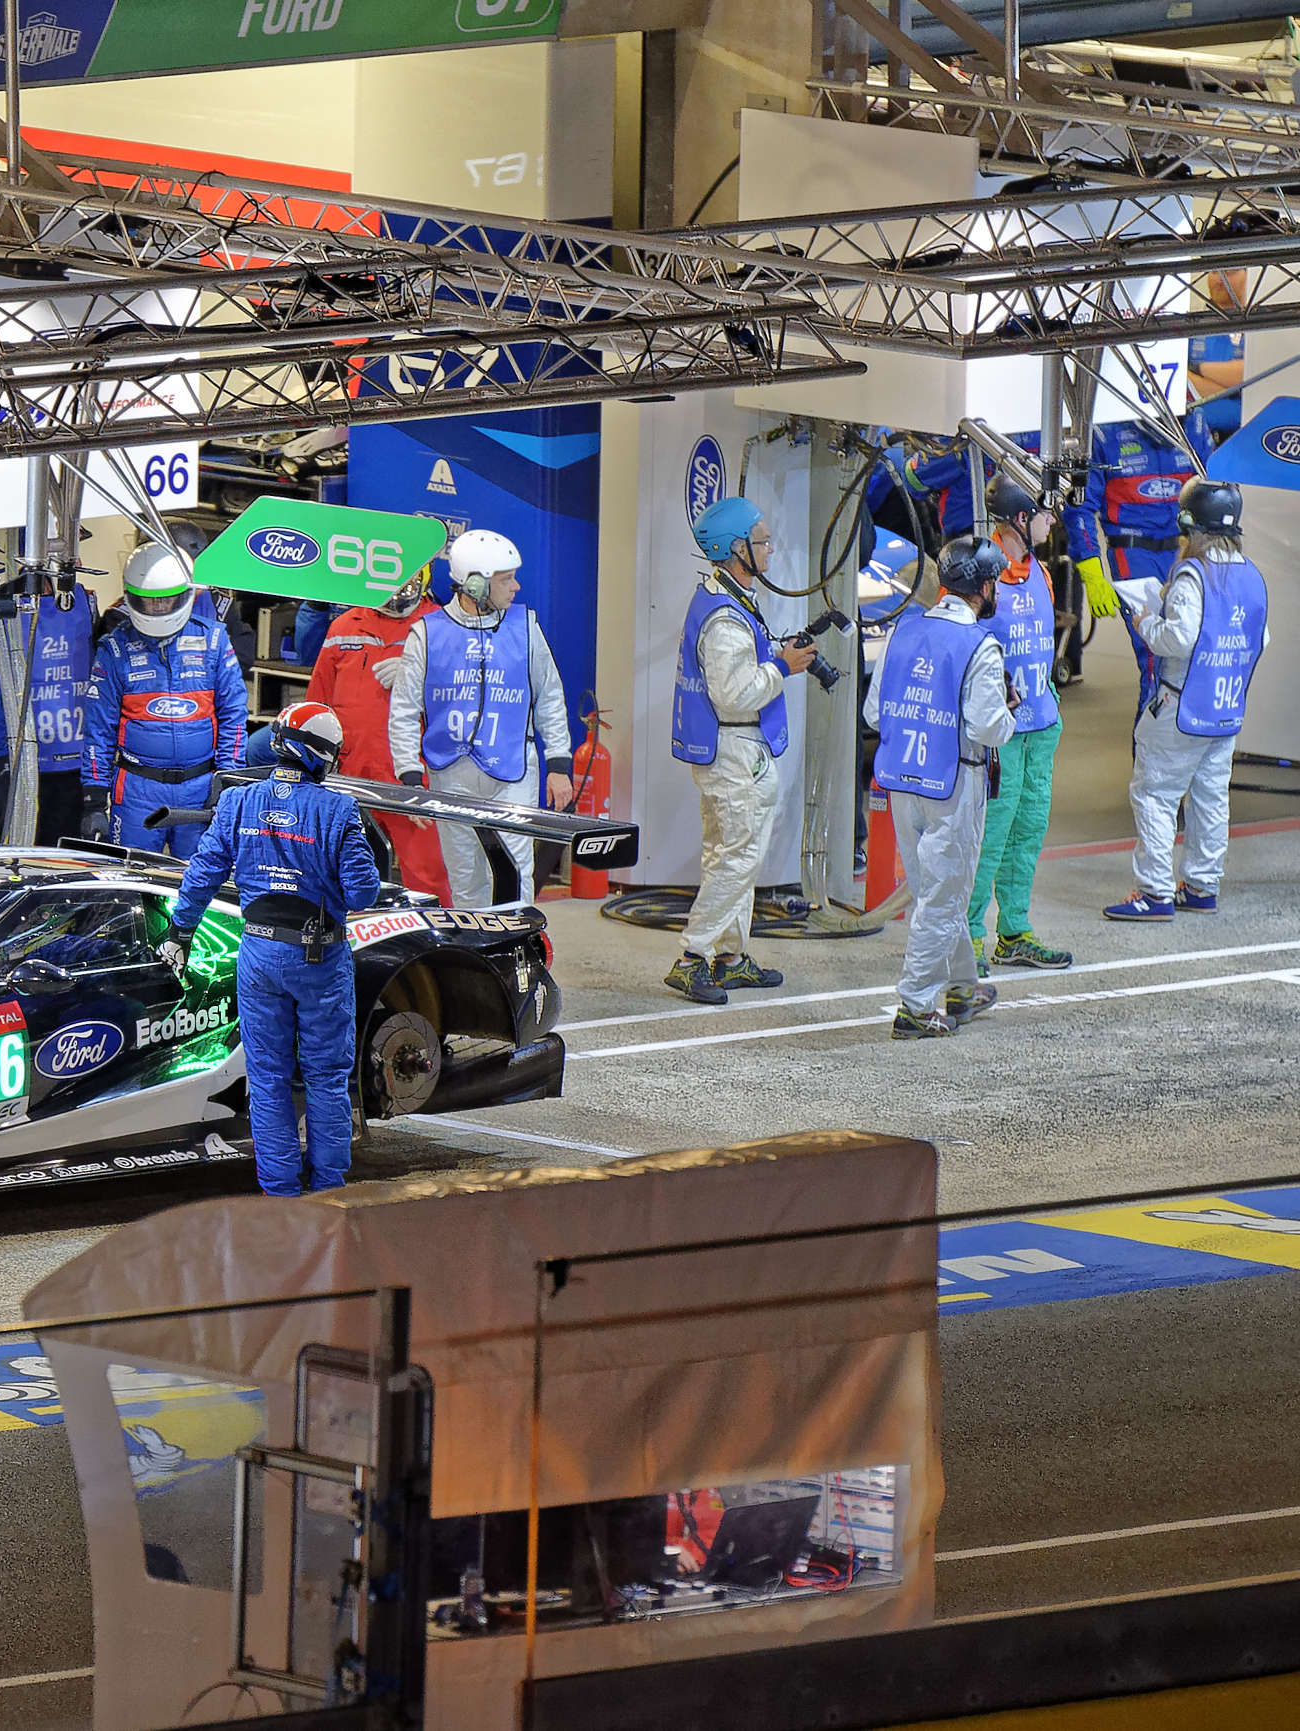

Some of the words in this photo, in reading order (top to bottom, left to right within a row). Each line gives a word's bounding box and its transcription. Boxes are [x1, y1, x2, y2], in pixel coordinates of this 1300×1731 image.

[145, 453, 189, 497] 66
[261, 531, 307, 562] Ford
[327, 534, 403, 580] 66
[1009, 622, 1025, 639] RH
[1003, 640, 1032, 658] LANE
[45, 665, 72, 682] FUEL
[30, 684, 60, 701] LANE
[490, 687, 524, 703] TRACK
[1214, 675, 1242, 710] 942
[155, 699, 188, 715] Ford
[38, 706, 84, 743] 862
[448, 710, 499, 746] 927
[902, 729, 928, 766] 76
[265, 811, 291, 825] Ford
[421, 799, 503, 822] Powered
[503, 813, 533, 825] by
[240, 827, 259, 836] FORD
[576, 833, 631, 855] GT
[356, 913, 421, 942] Castrol
[423, 911, 531, 931] EDGE
[136, 998, 230, 1048] EcoBoost
[51, 1029, 105, 1071] Ford
[135, 1150, 200, 1168] brembo
